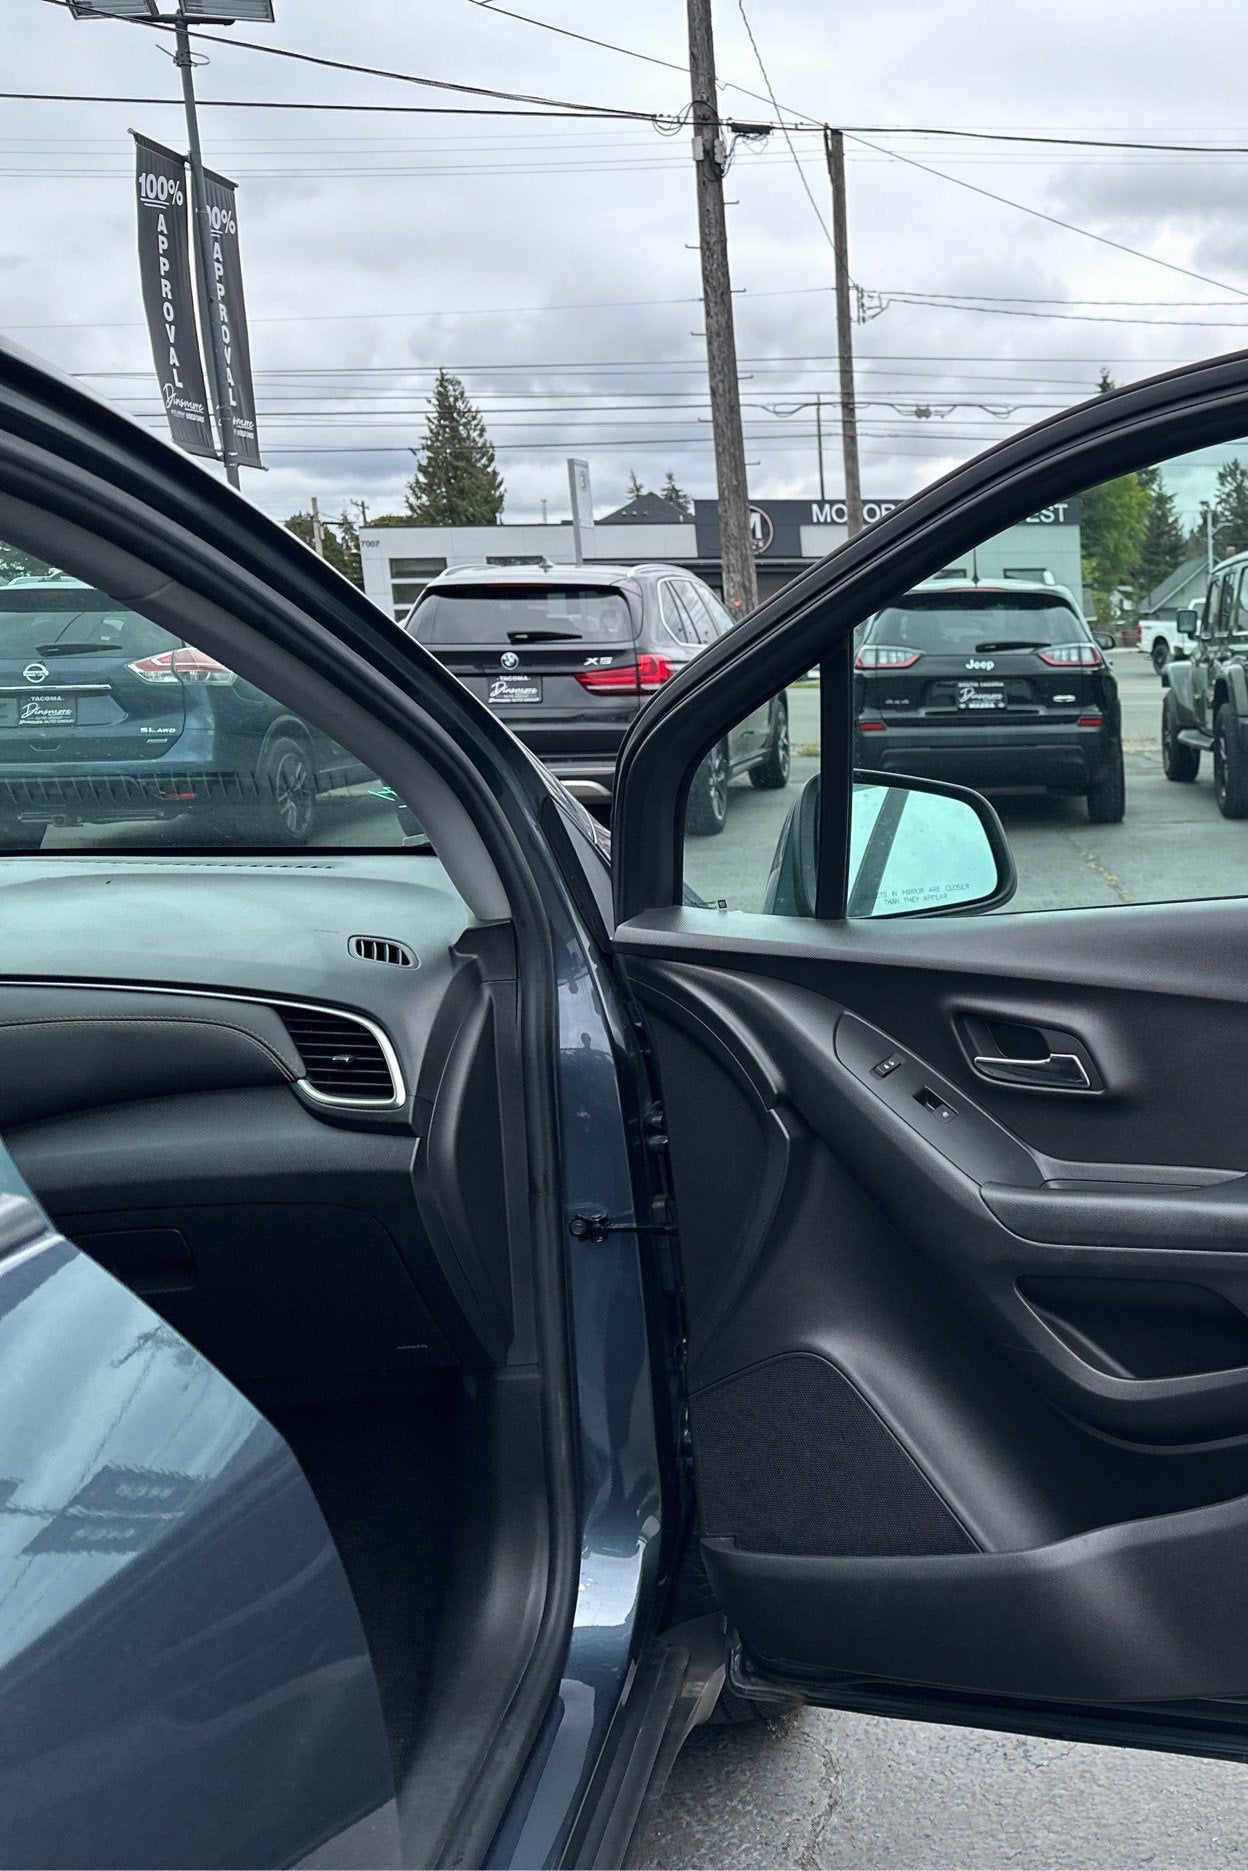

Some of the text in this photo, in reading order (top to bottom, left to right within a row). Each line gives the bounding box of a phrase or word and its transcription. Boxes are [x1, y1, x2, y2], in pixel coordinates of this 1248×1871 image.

[139, 173, 184, 206] 100%
[157, 213, 184, 389] APPROVAL
[213, 241, 237, 407] APPROVAL
[965, 659, 995, 671] Jeep
[902, 887, 925, 895] MIRROR
[929, 885, 941, 893] ARE
[945, 883, 970, 892] CLOSER
